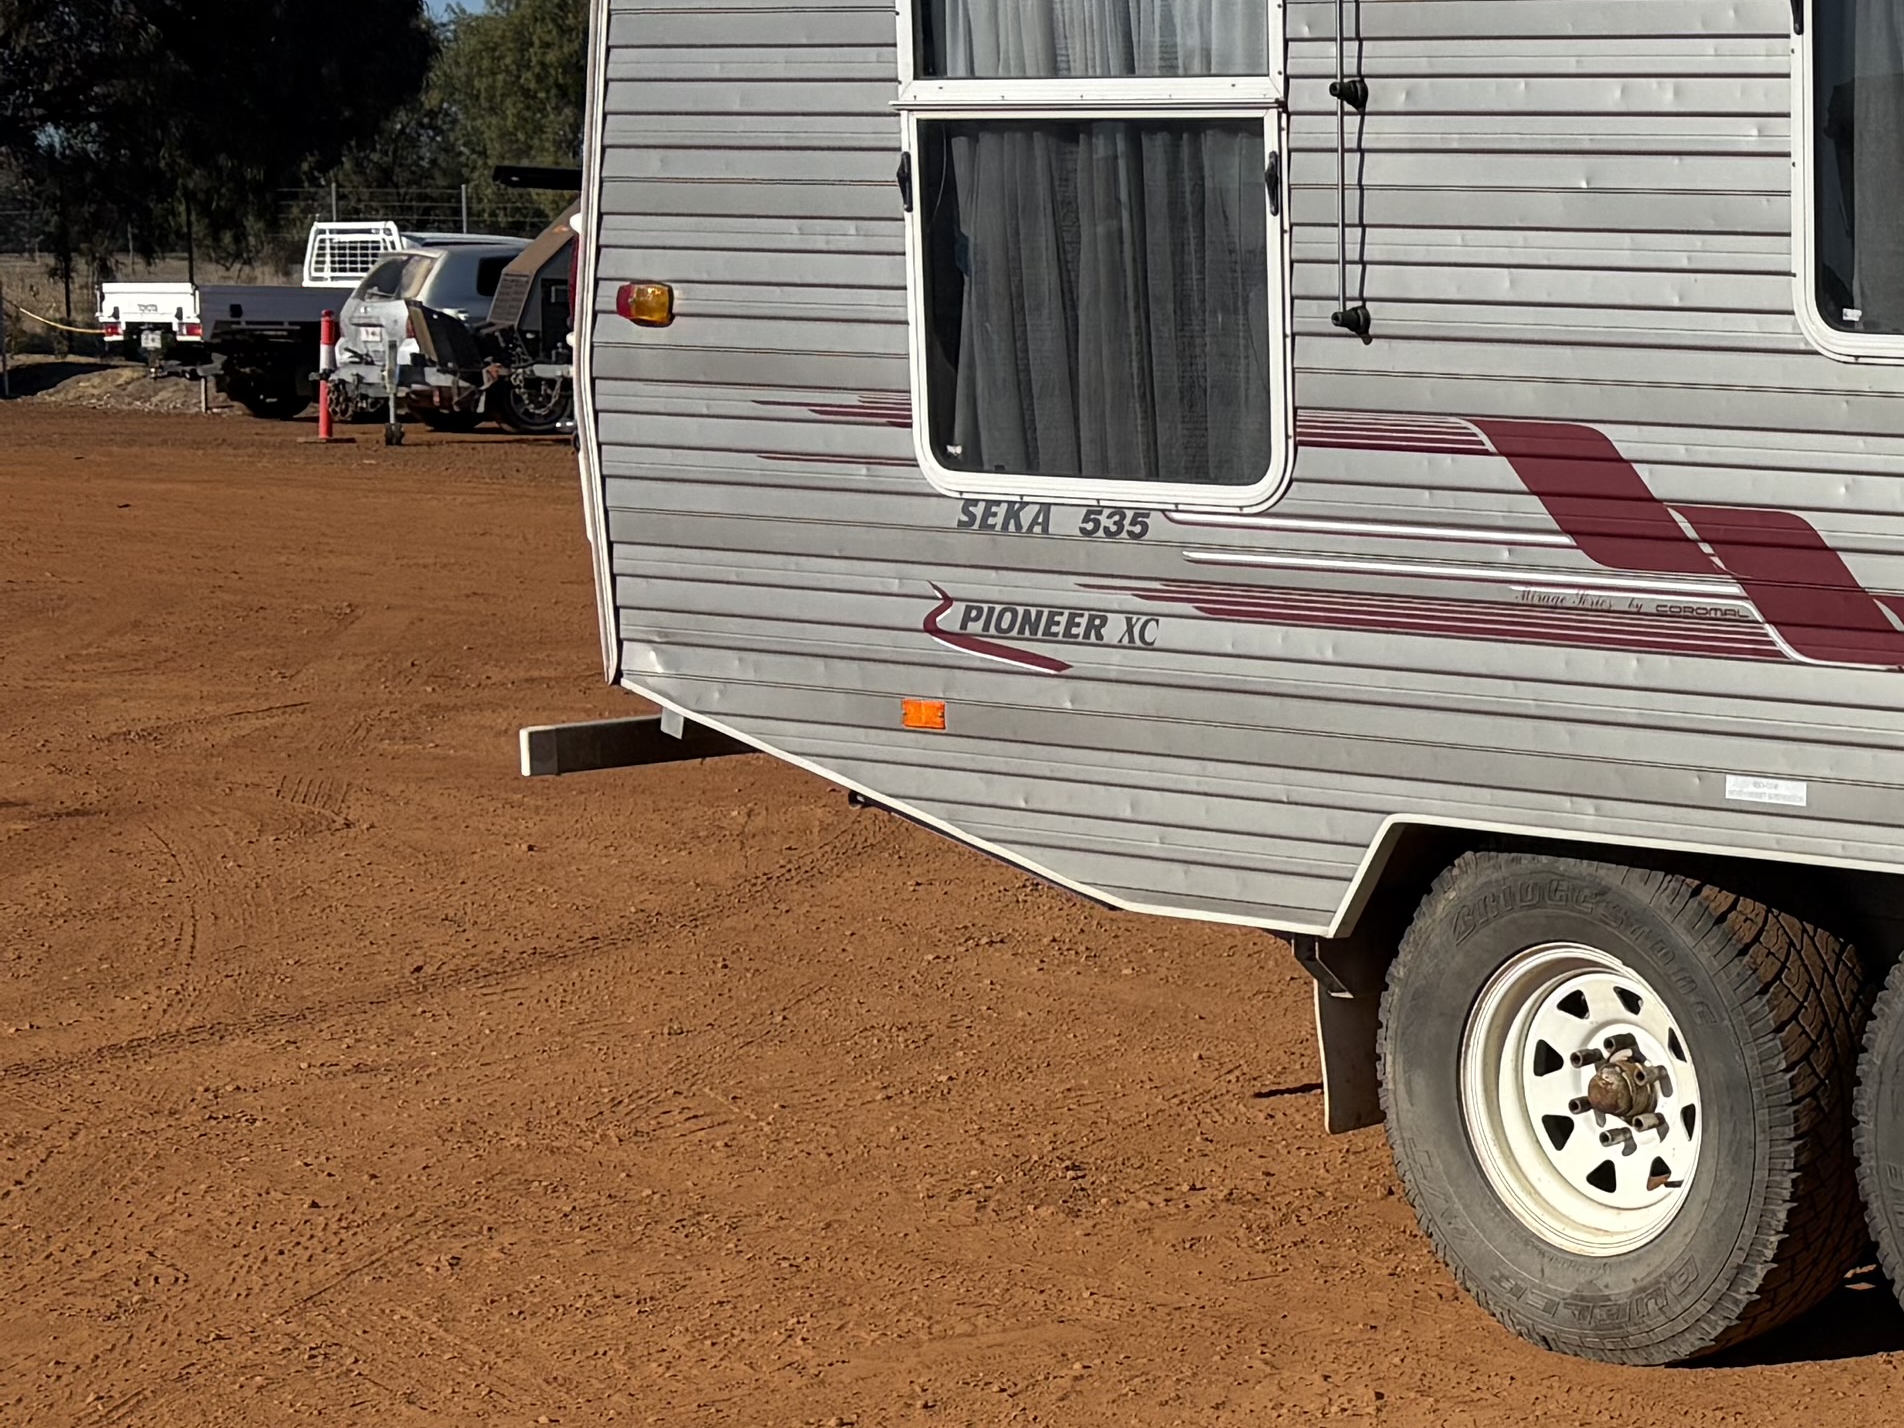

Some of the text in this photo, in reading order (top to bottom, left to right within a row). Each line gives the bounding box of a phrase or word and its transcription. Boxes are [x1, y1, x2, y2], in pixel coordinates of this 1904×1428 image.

[956, 499, 1151, 540] SEKA 535
[959, 604, 1160, 647] PIONEER XC
